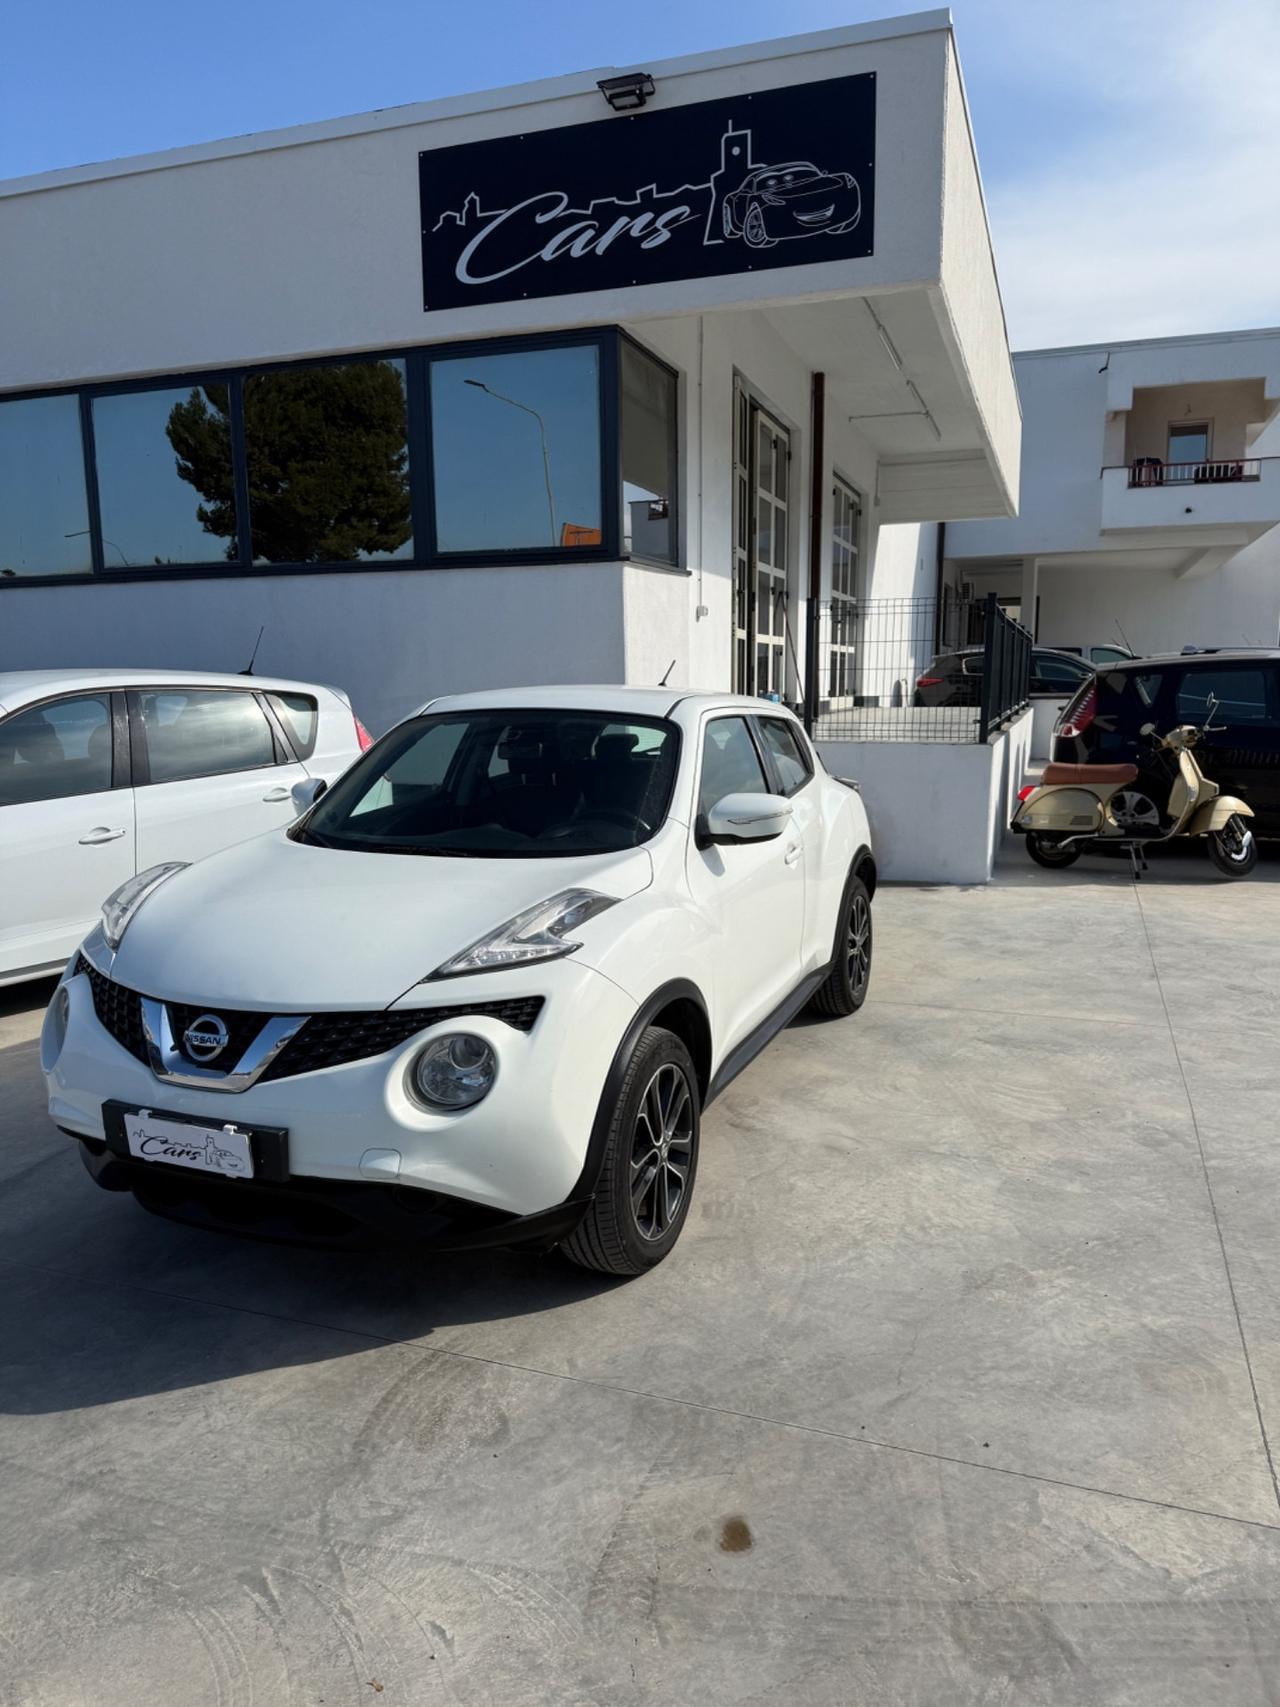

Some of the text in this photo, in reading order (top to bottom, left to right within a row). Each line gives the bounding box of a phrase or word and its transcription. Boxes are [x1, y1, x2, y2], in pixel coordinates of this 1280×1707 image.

[455, 191, 702, 285] Cars
[185, 1032, 222, 1046] NISSAN
[140, 1136, 204, 1161] Cars
